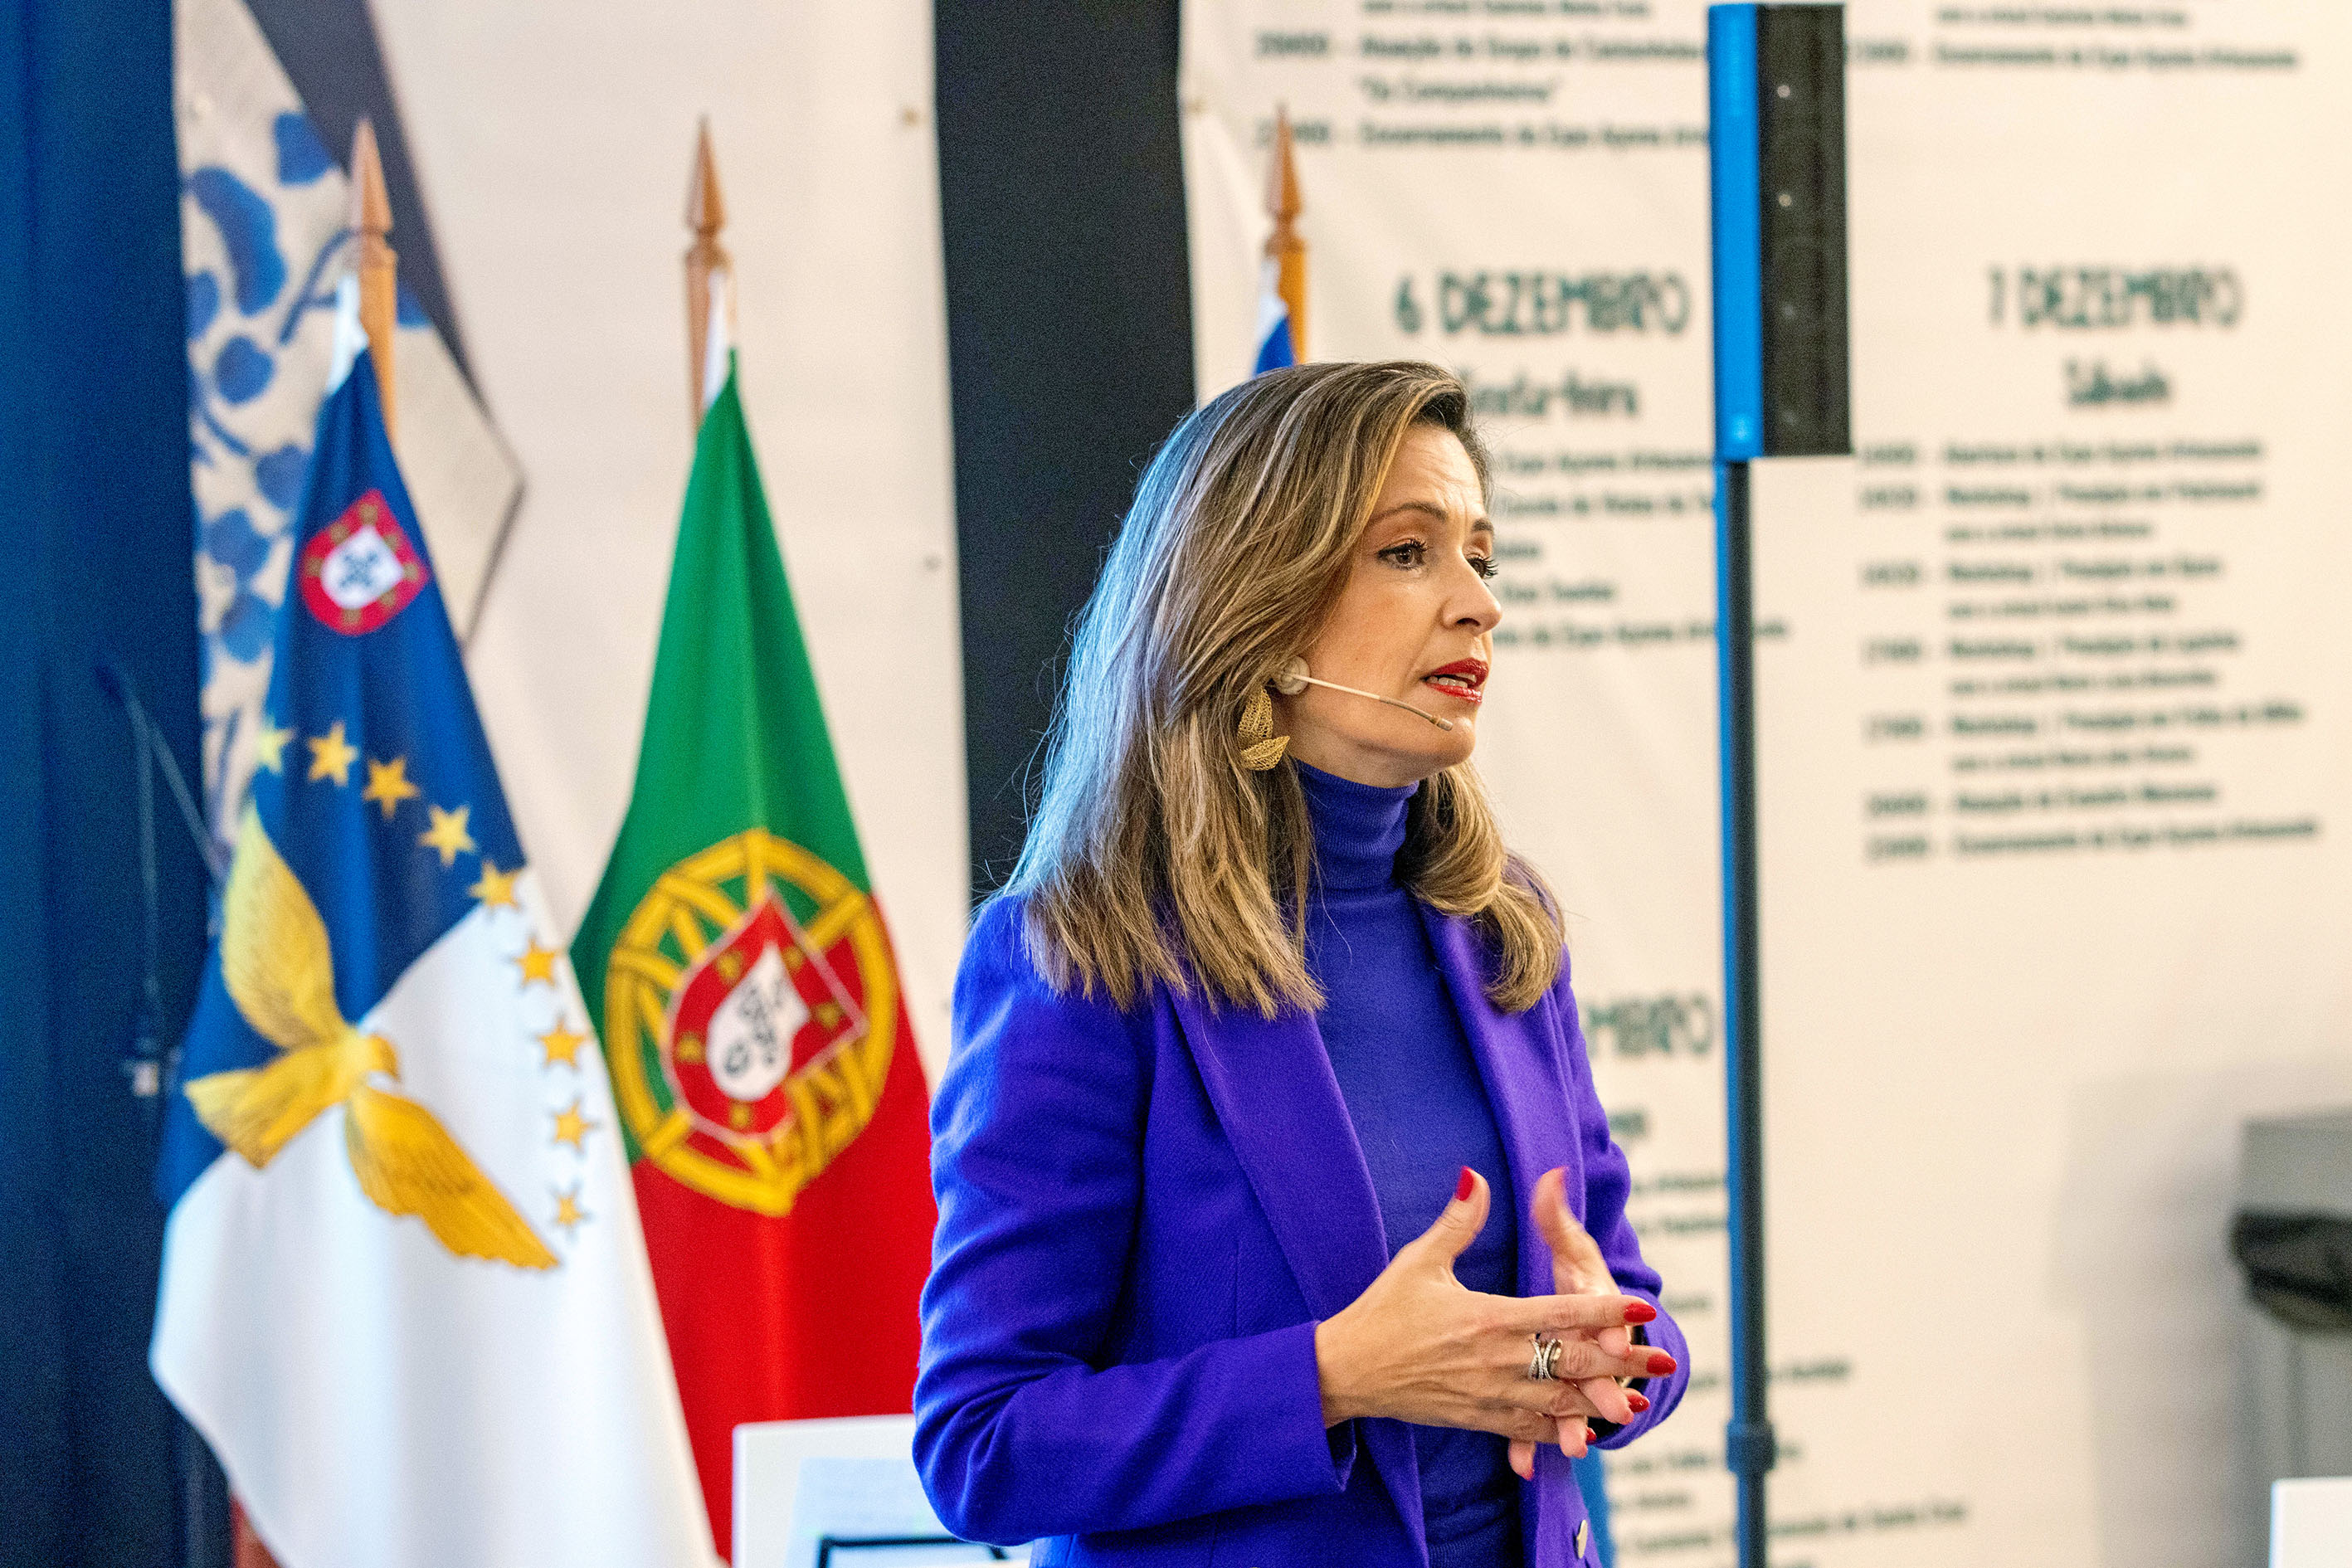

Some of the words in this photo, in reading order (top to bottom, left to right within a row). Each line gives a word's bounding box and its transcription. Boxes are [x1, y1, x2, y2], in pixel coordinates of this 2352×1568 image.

[1395, 277, 1422, 337] 6
[1439, 272, 1688, 337] DEZEMBRO
[2021, 267, 2239, 329] DEZEMBRO
